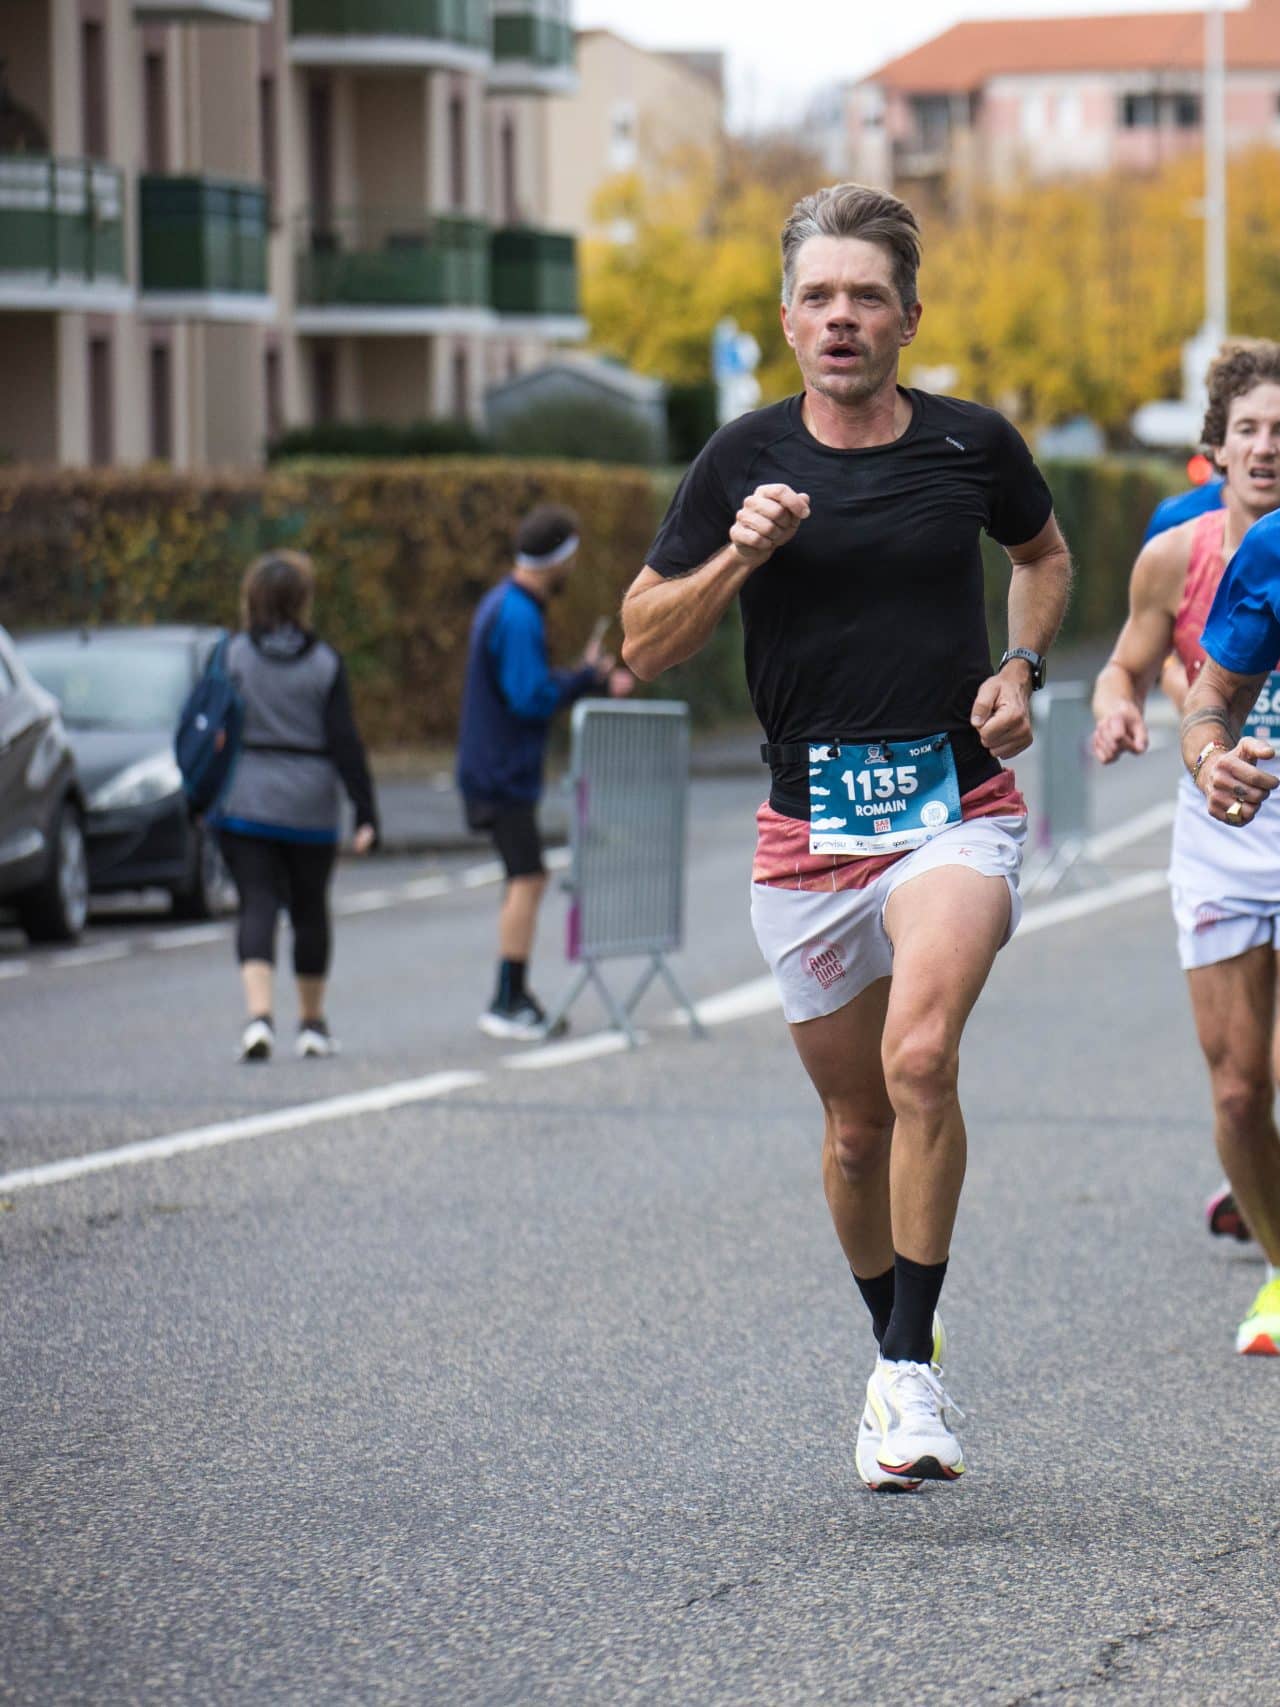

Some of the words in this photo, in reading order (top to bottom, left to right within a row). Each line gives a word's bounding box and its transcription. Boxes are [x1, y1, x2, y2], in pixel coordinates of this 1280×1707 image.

[909, 749, 920, 757] 10
[920, 744, 932, 753] KM
[841, 766, 918, 801] 1135
[855, 799, 908, 816] ROMAIN
